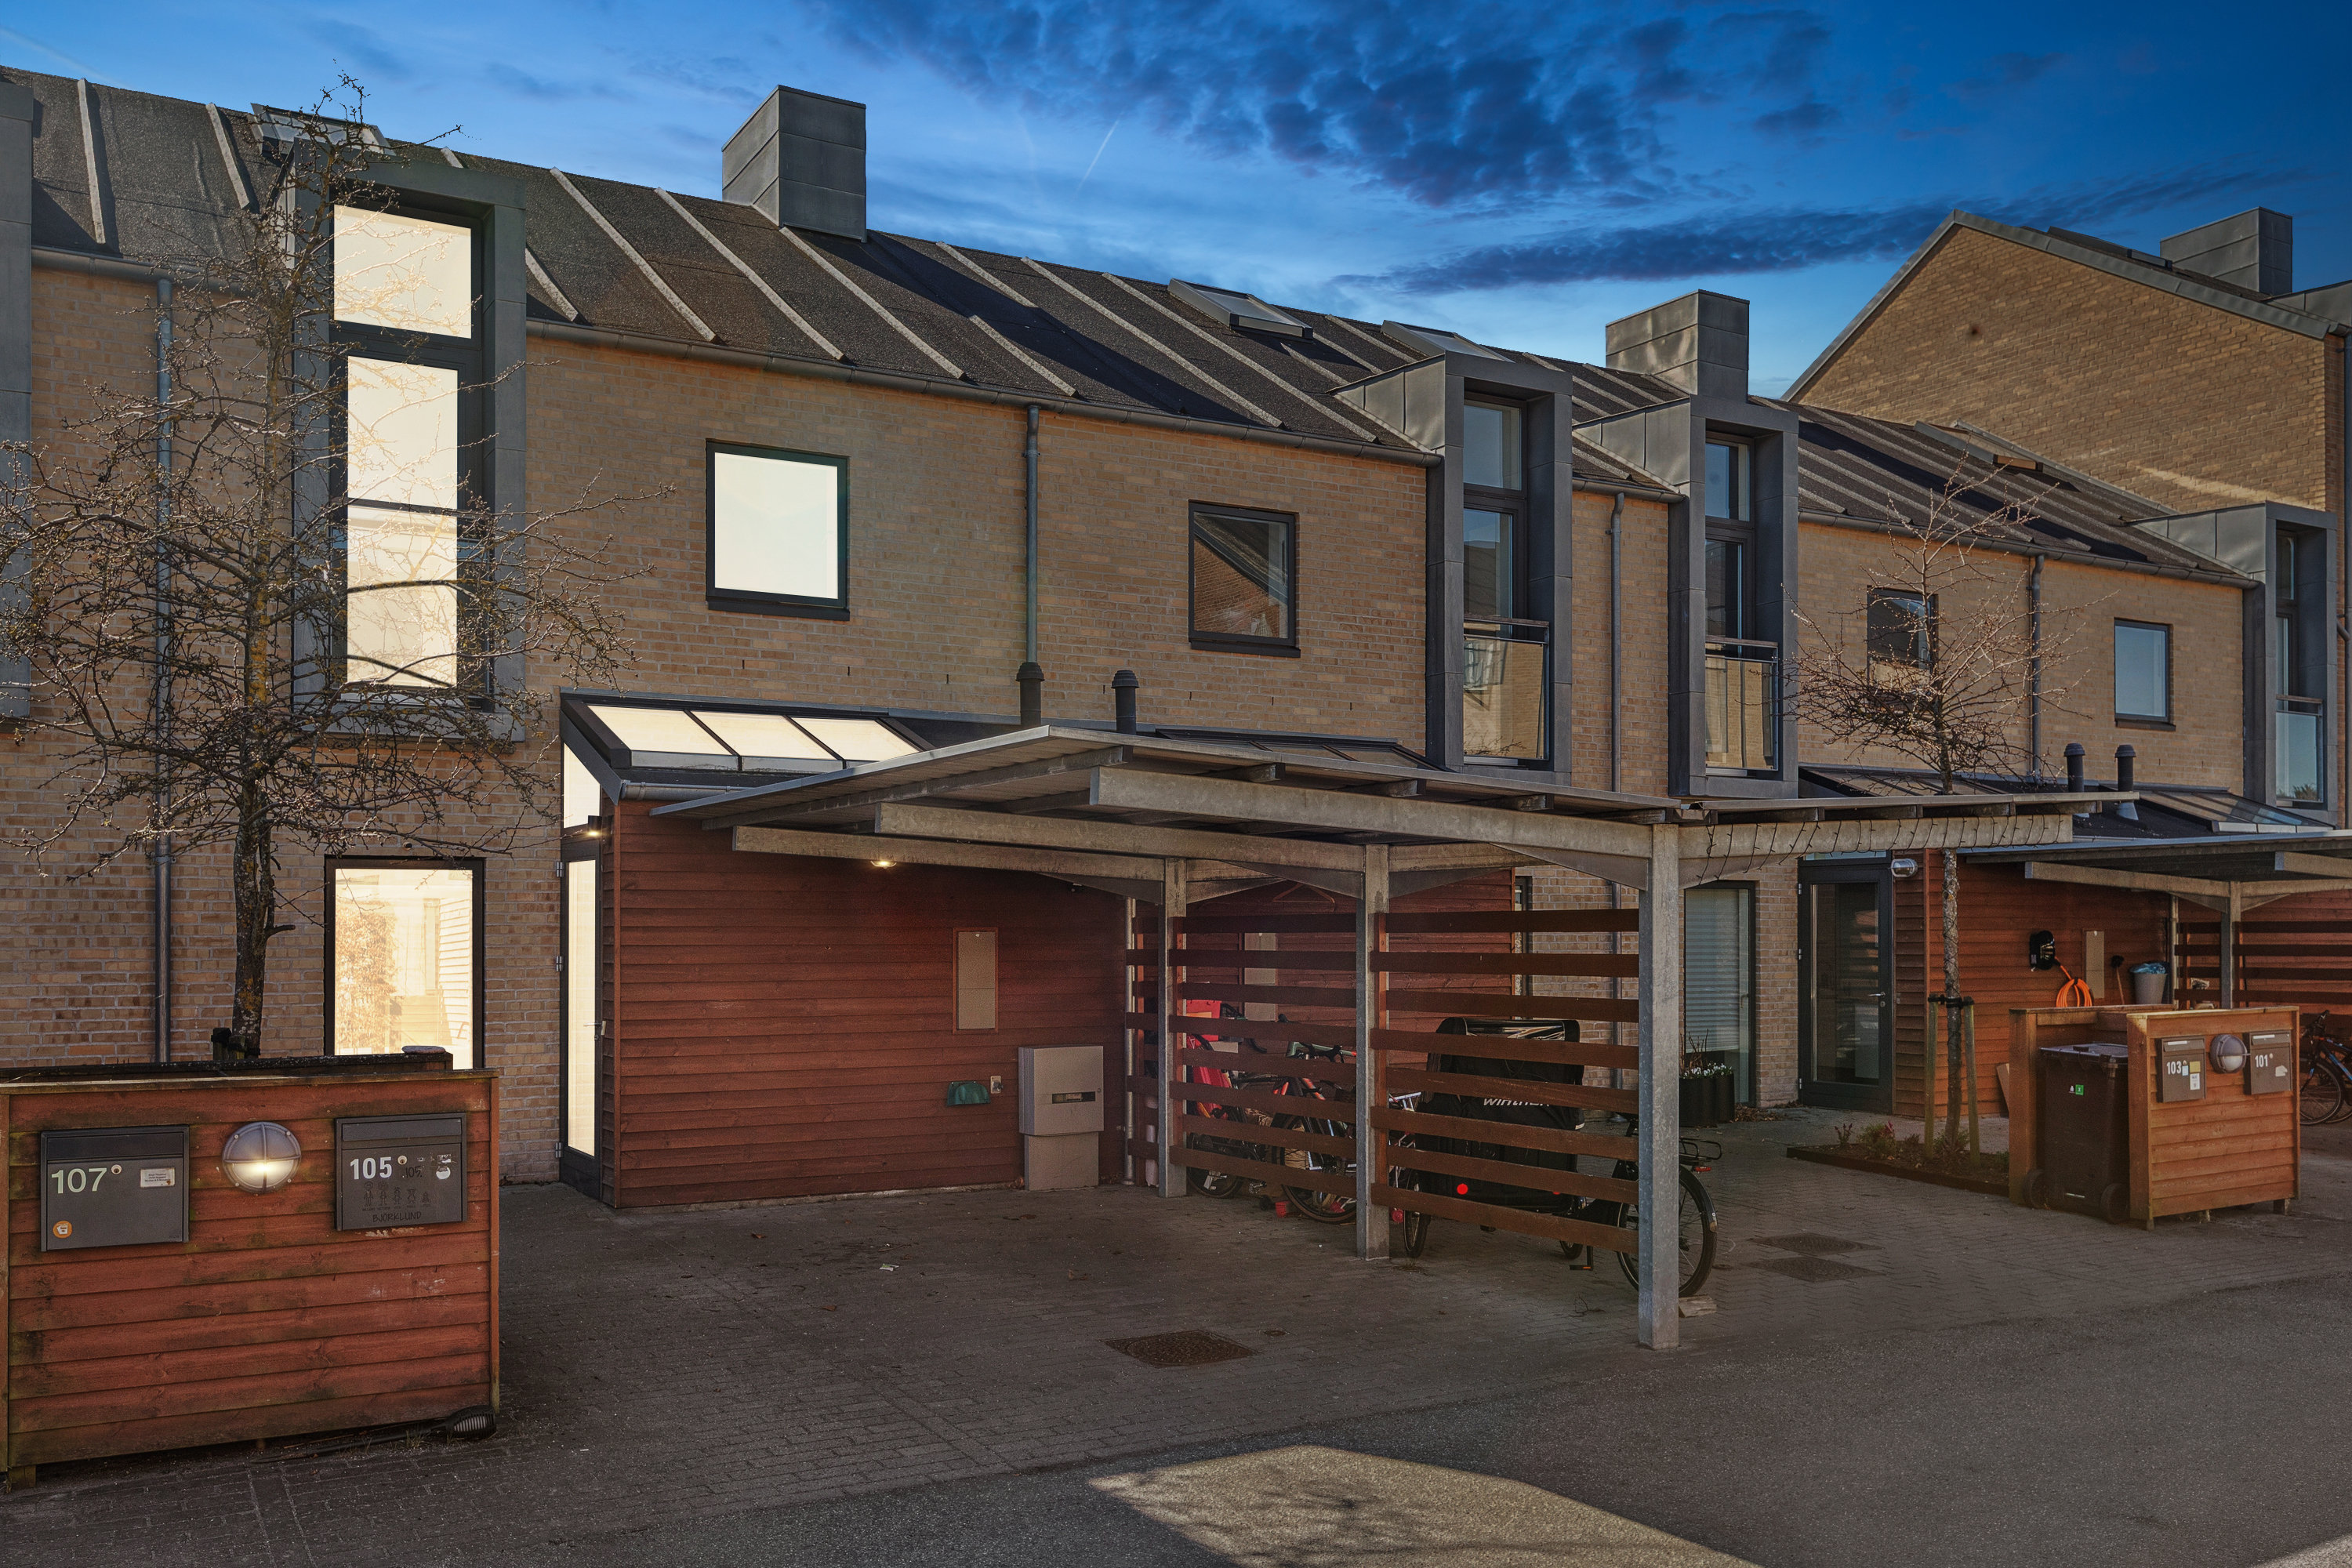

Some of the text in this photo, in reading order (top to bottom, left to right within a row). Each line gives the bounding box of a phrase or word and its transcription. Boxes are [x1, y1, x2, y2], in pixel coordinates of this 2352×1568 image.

[2166, 1061, 2182, 1075] 103
[2255, 1054, 2268, 1068] 101
[350, 1156, 392, 1180] 105
[51, 1167, 107, 1194] 107
